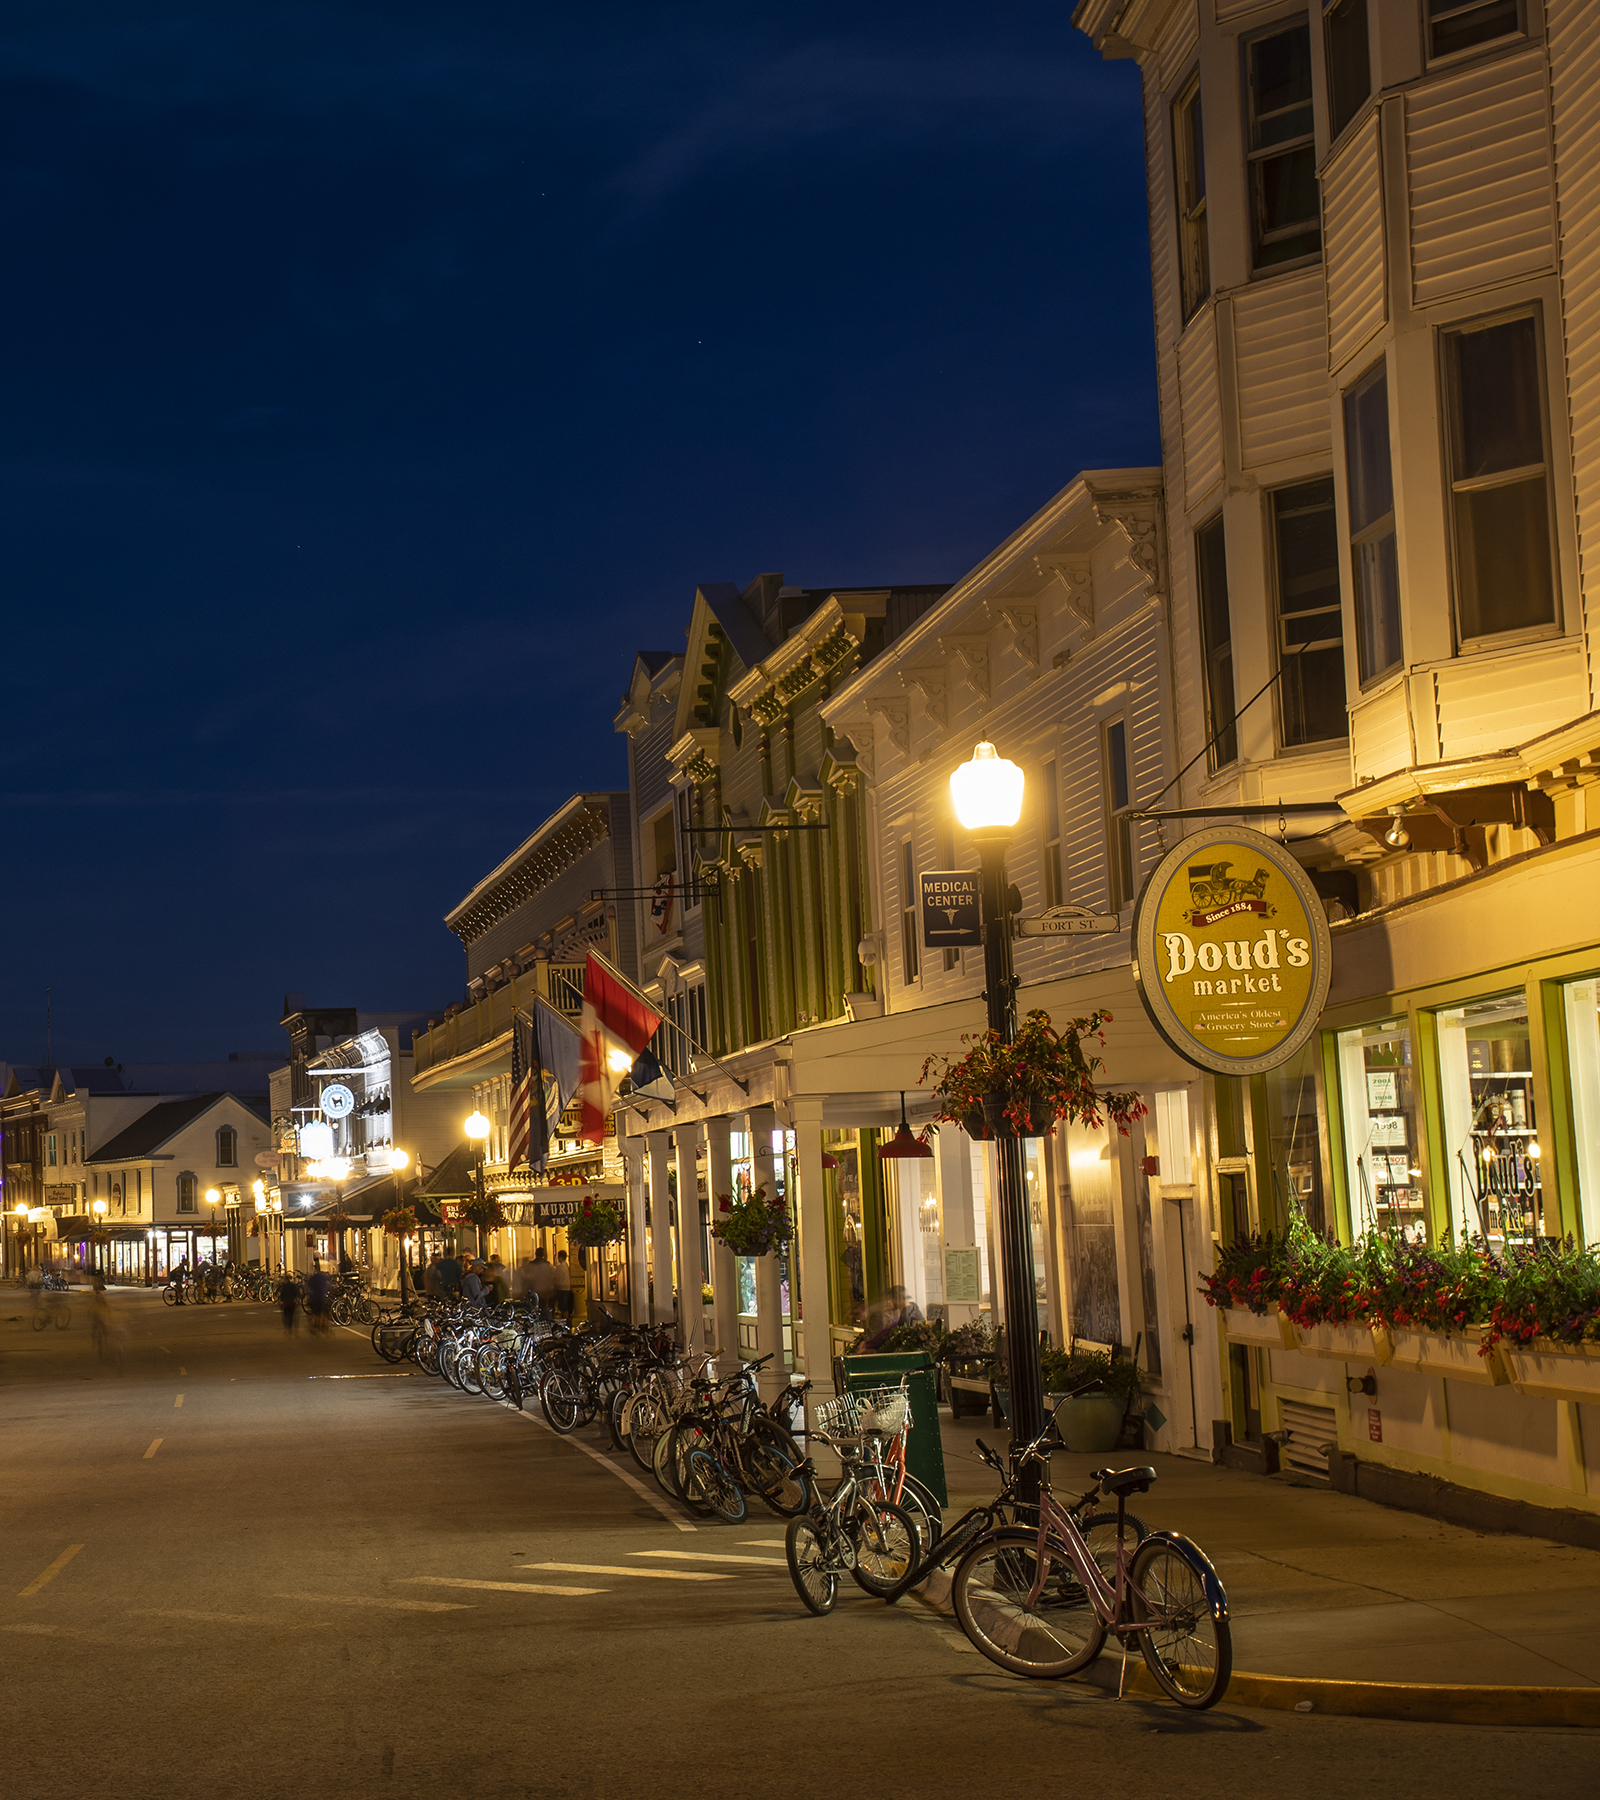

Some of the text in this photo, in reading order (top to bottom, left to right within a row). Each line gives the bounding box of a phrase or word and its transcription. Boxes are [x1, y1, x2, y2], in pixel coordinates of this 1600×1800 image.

[924, 881, 976, 893] MEDICAL
[927, 895, 974, 907] CENTER
[1205, 902, 1253, 924] Since 1884
[1041, 919, 1099, 931] FORT ST.
[1158, 929, 1310, 983] Doud's
[1193, 973, 1283, 996] market
[1199, 1009, 1282, 1021] America's Oldest
[1206, 1019, 1276, 1032] Grocery Store
[556, 1177, 583, 1186] 3-D
[552, 1217, 566, 1225] THE
